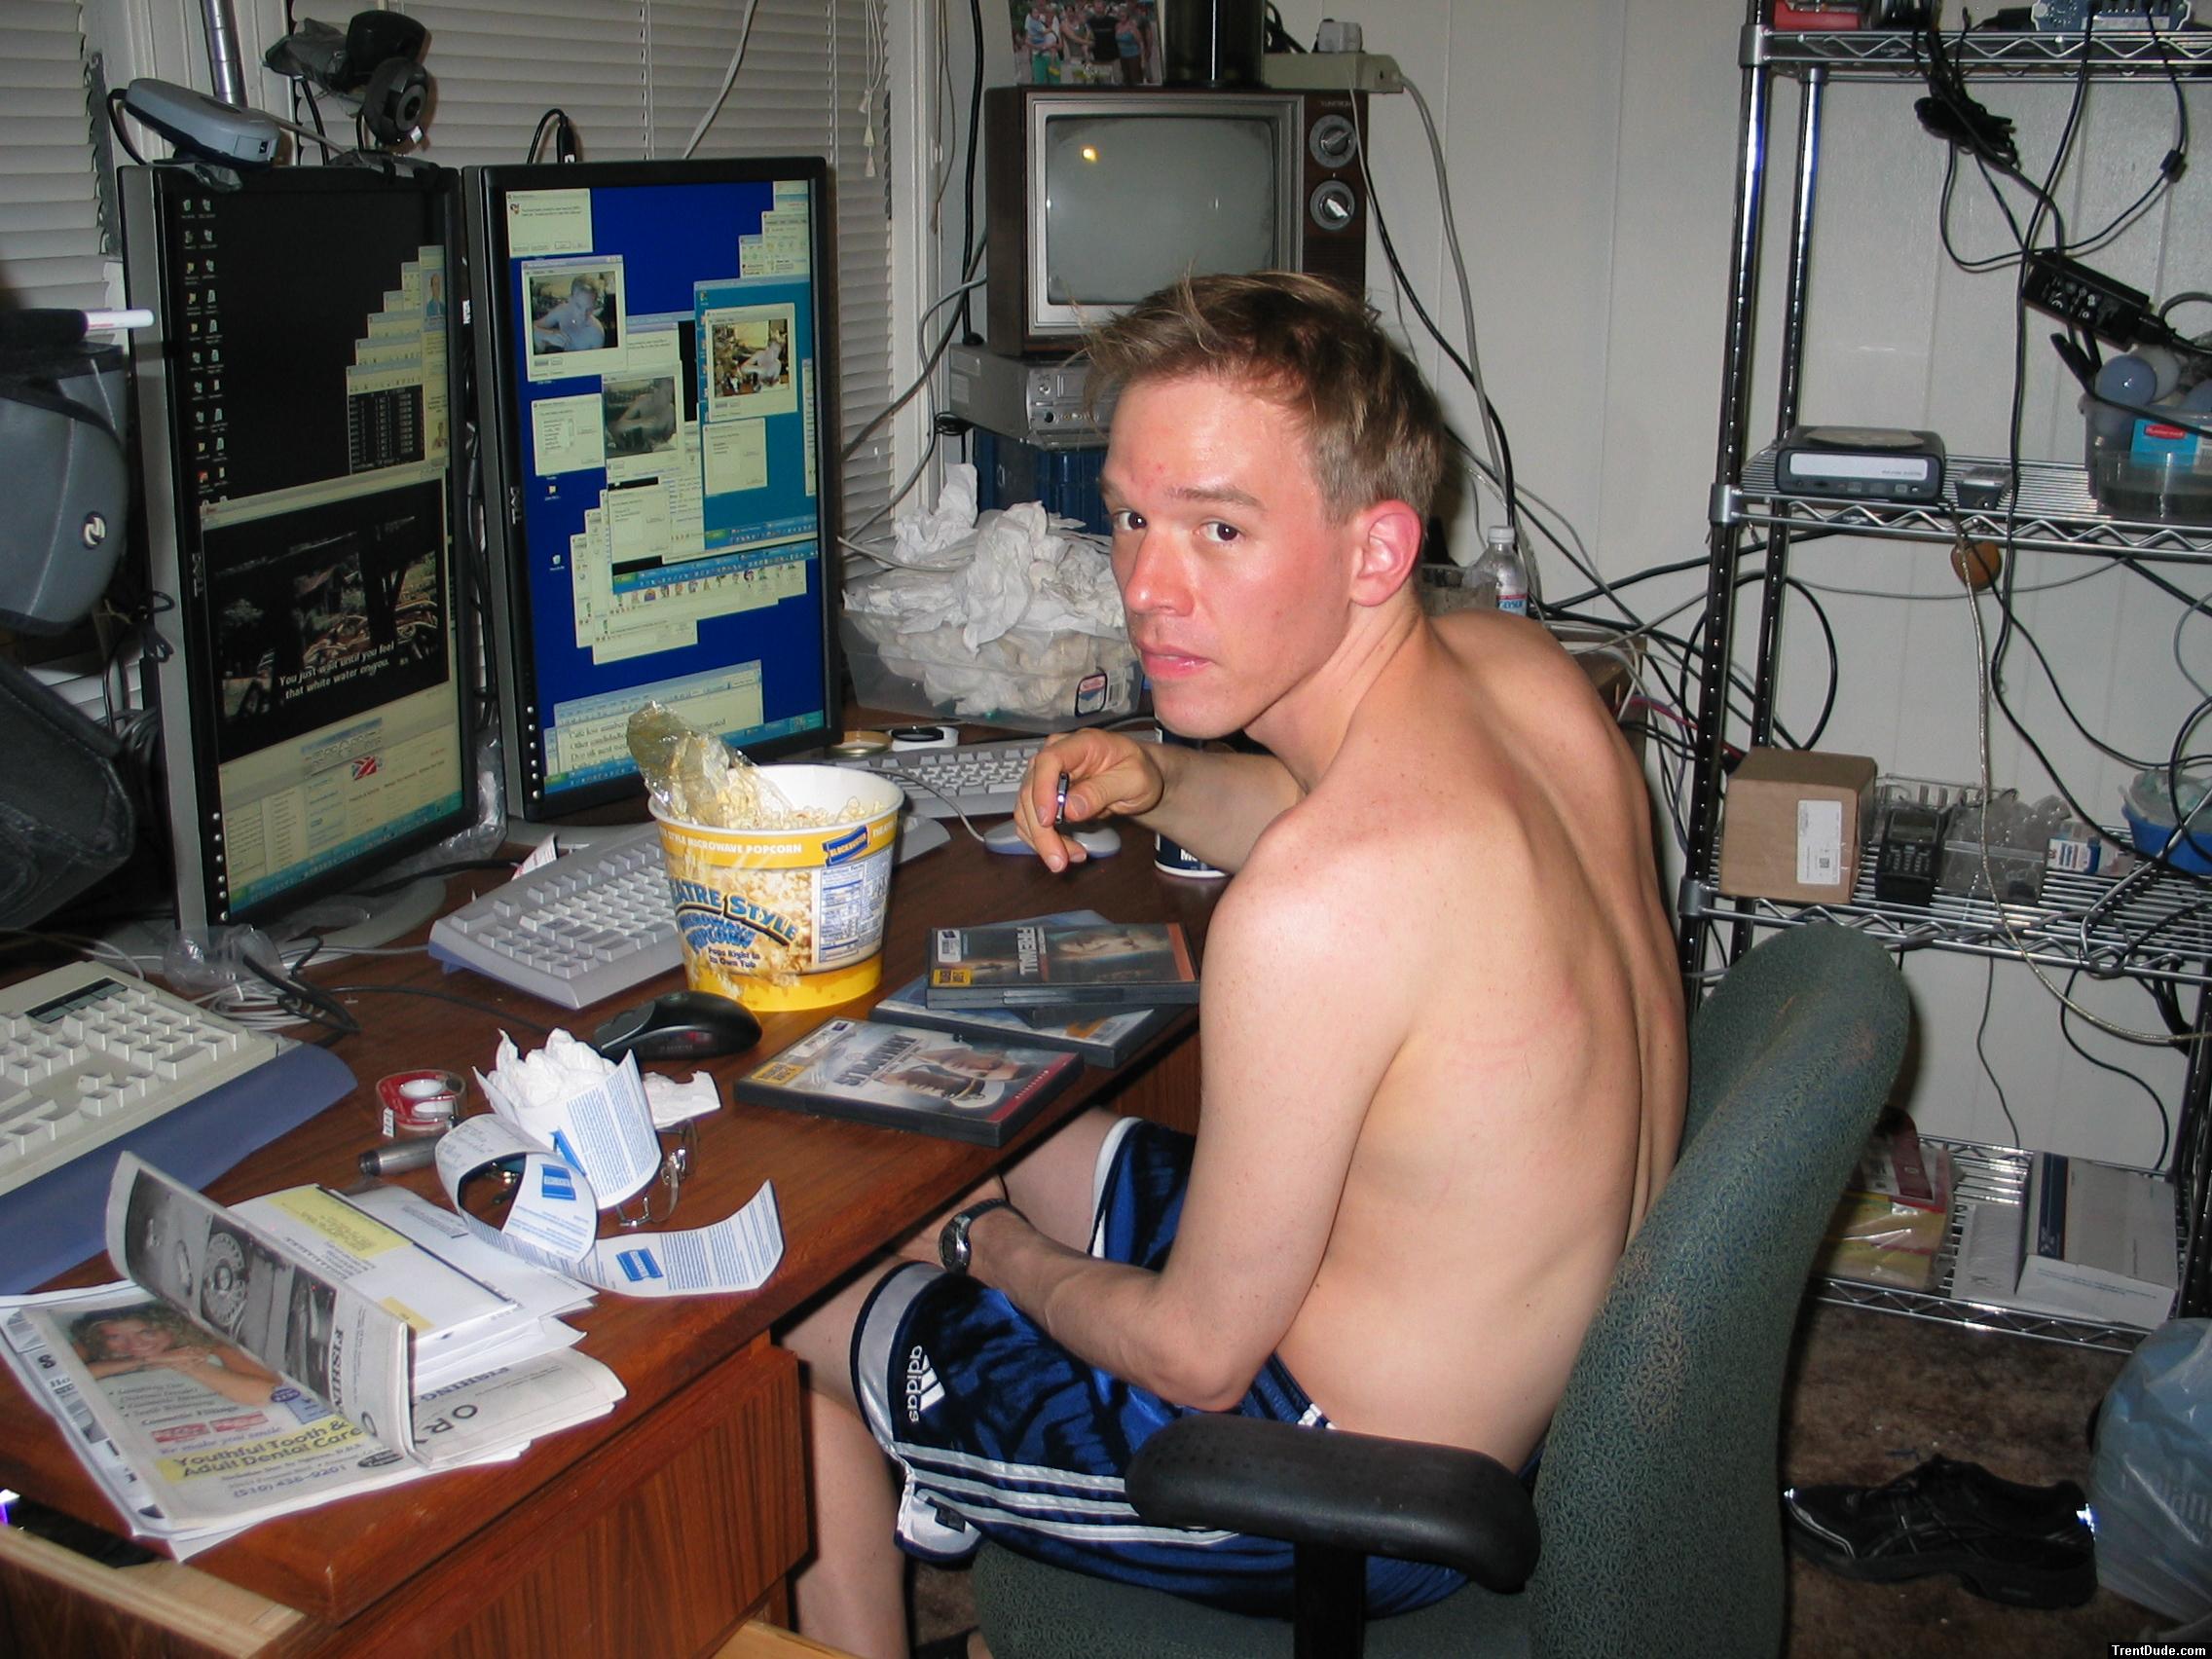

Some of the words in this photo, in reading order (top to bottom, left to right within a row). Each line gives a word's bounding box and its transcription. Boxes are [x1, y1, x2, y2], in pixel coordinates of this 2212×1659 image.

[279, 676, 298, 686] You
[299, 669, 316, 683] just
[318, 660, 338, 673] wait
[340, 653, 360, 666] until
[361, 647, 378, 662] you
[379, 641, 394, 653] feel
[285, 685, 305, 699] that
[307, 679, 330, 692] white
[333, 670, 358, 682] water
[687, 837, 743, 853] MICROWAVE
[746, 843, 802, 854] POPCORN
[728, 895, 797, 940] STYLE
[720, 957, 739, 966] Own
[728, 949, 750, 961] Right
[1016, 926, 1039, 976] FIREWALL
[421, 1366, 511, 1402] FISHING
[905, 1345, 923, 1422] adidas
[176, 1443, 266, 1467] Youthful
[267, 1426, 327, 1450] Tooth
[329, 1419, 349, 1431] &
[183, 1459, 240, 1478] Adult
[241, 1444, 311, 1466] Dental
[313, 1426, 362, 1449] Care
